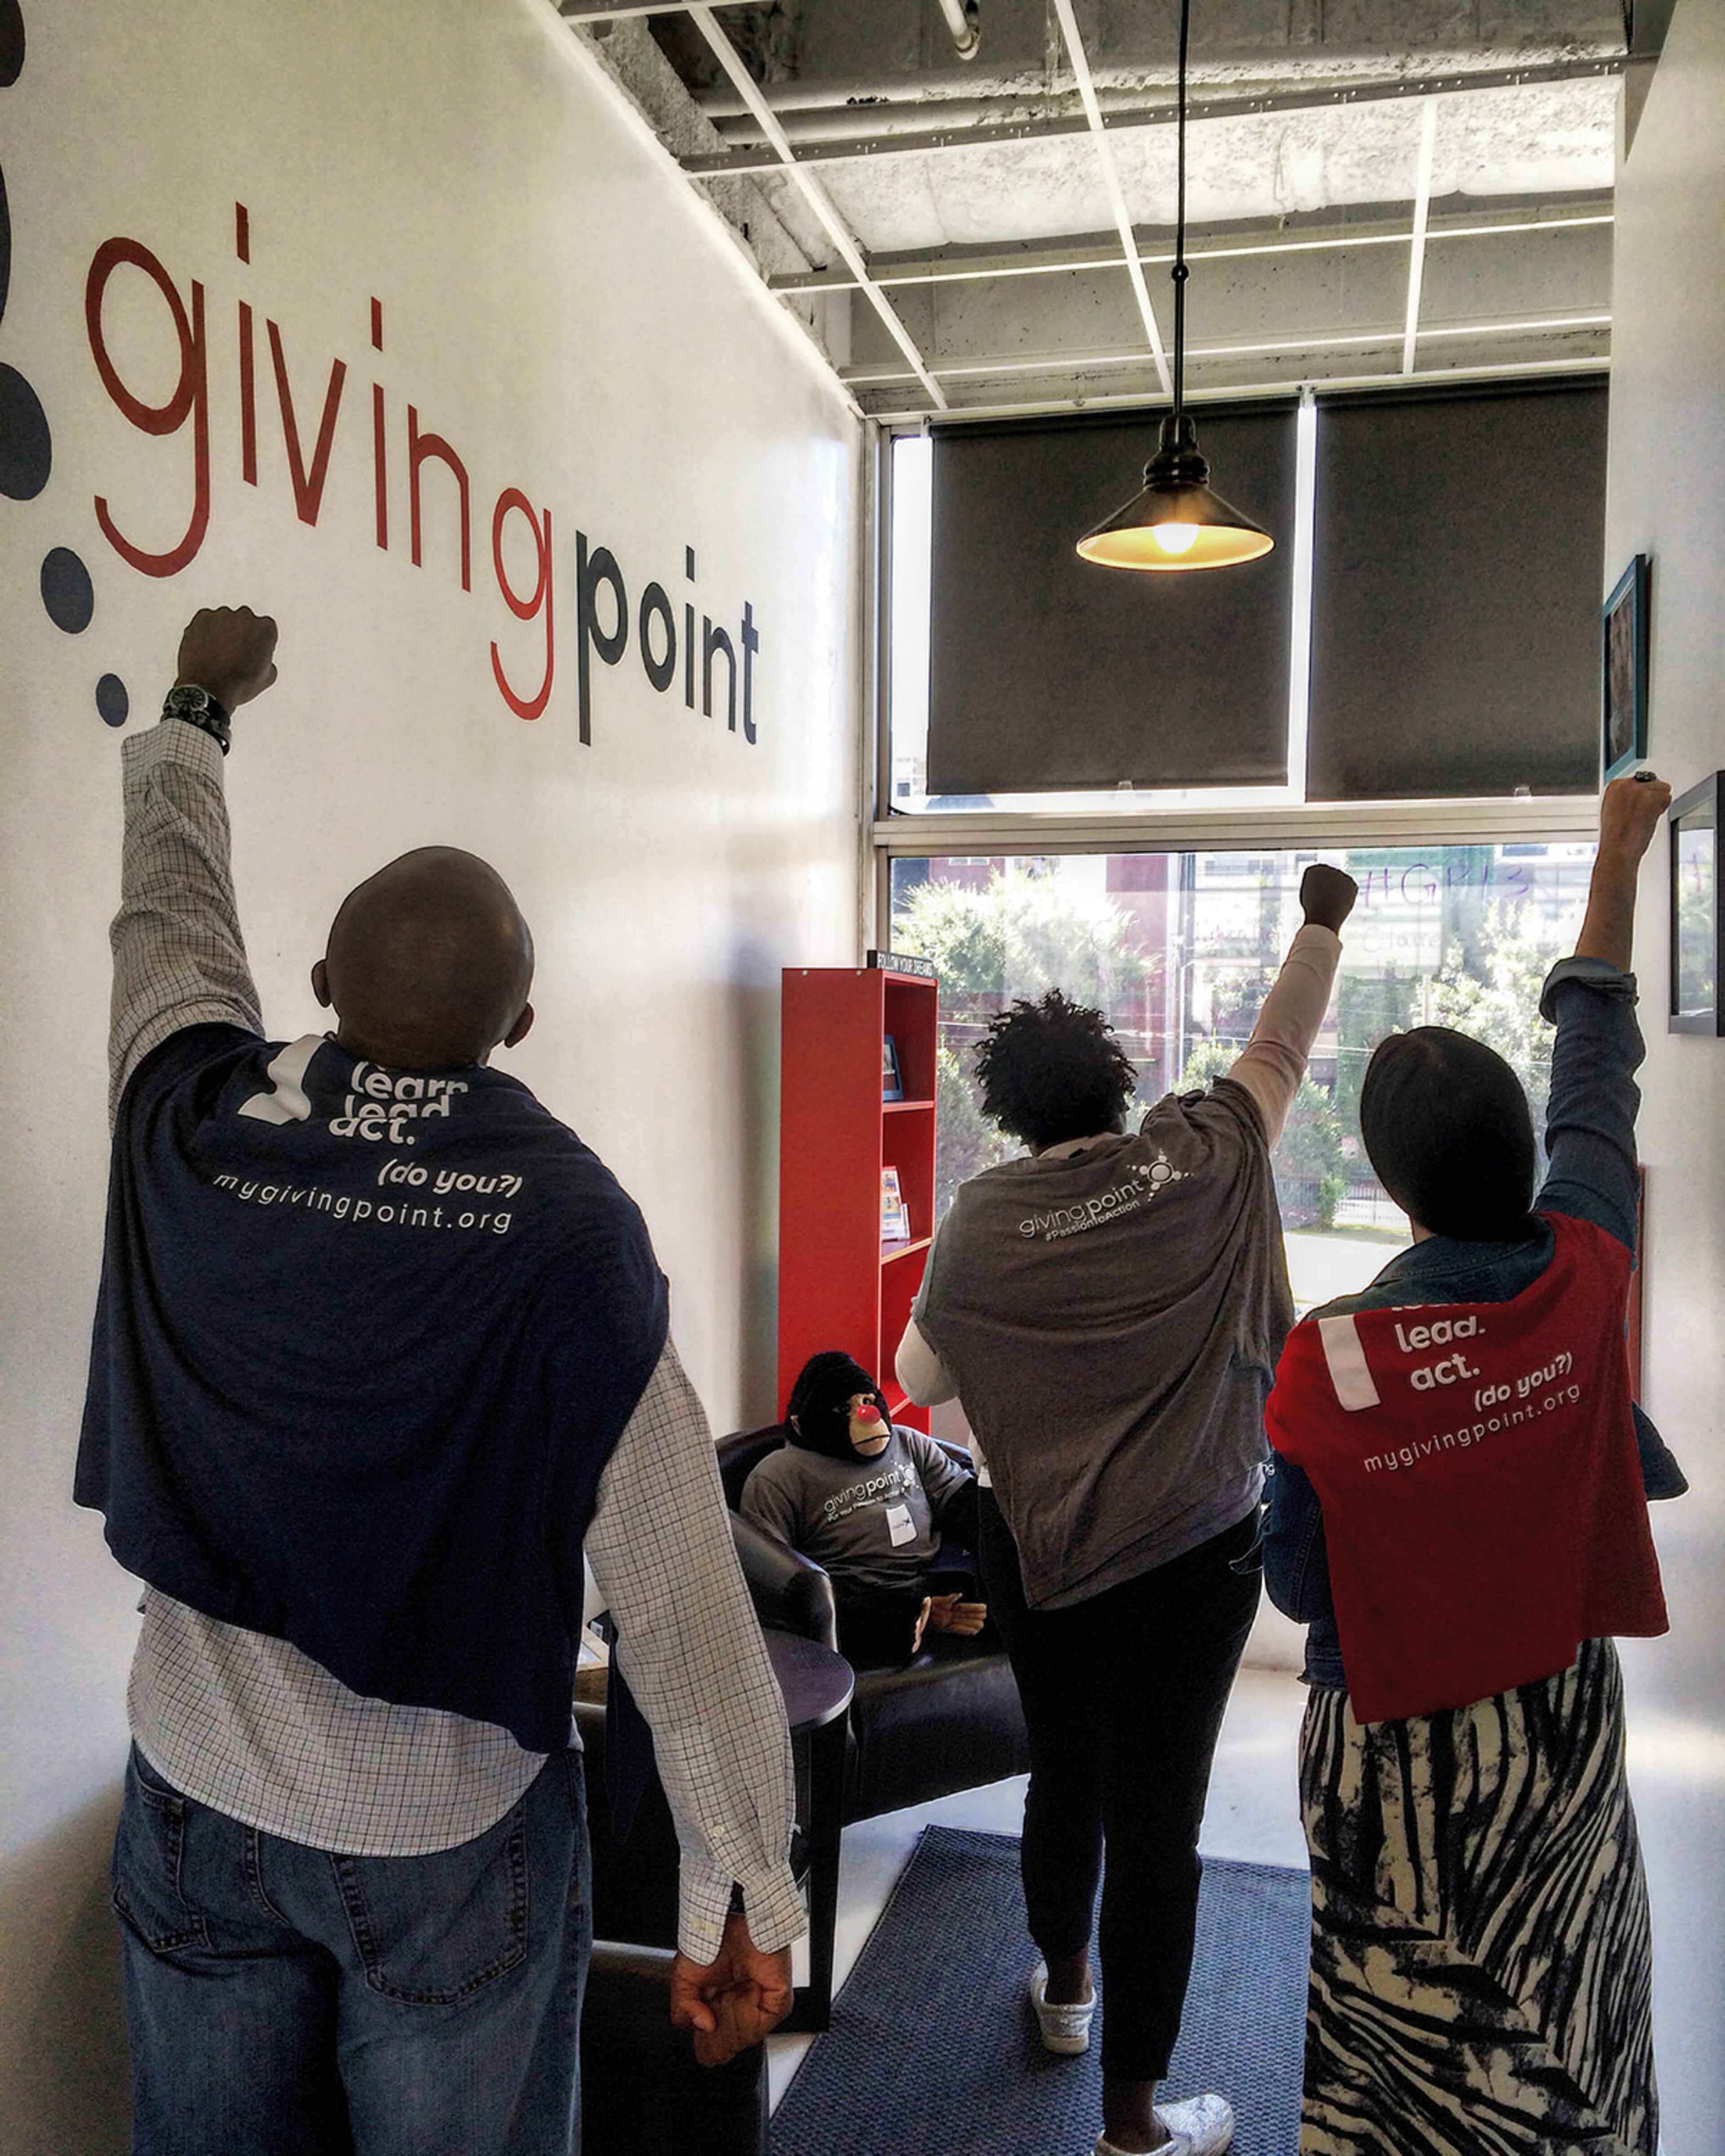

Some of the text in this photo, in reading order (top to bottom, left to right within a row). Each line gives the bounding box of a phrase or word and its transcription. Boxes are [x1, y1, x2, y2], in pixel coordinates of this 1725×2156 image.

[328, 1117, 416, 1145] act.
[377, 1158, 523, 1199] (do you?)
[213, 1172, 513, 1234] mygivingpoint.org
[1394, 1316, 1486, 1353] lead.
[1410, 1353, 1480, 1391] act.
[1474, 1352, 1573, 1411] (do you?)
[1363, 1383, 1581, 1473] mygivingpoint.org
